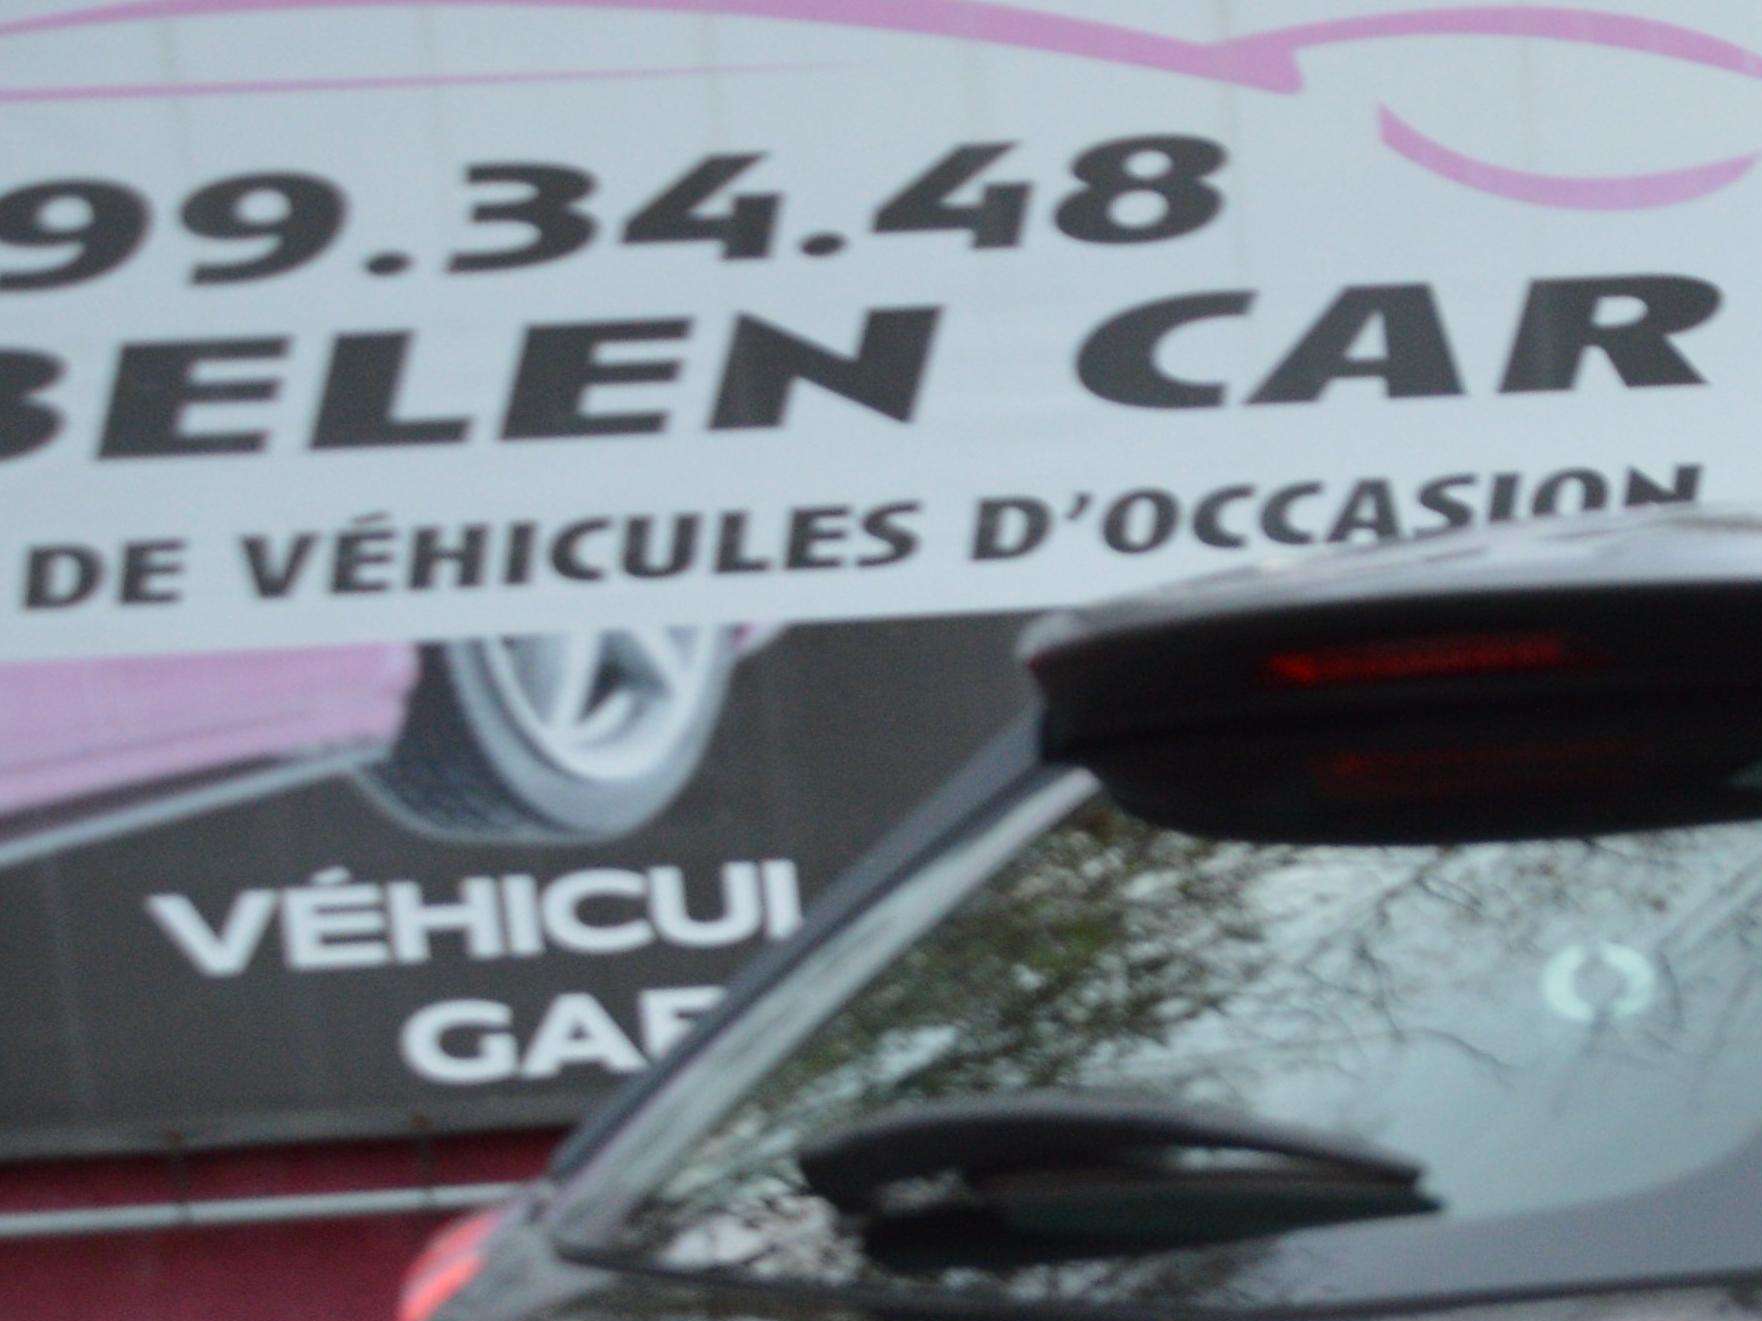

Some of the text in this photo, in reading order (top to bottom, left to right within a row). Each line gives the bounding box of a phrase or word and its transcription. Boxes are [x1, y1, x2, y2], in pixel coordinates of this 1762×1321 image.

[0, 134, 1229, 292] 99.34.48
[1073, 272, 1723, 409] CAR
[22, 464, 1704, 611] DE VÉHICULES D'OCCASION
